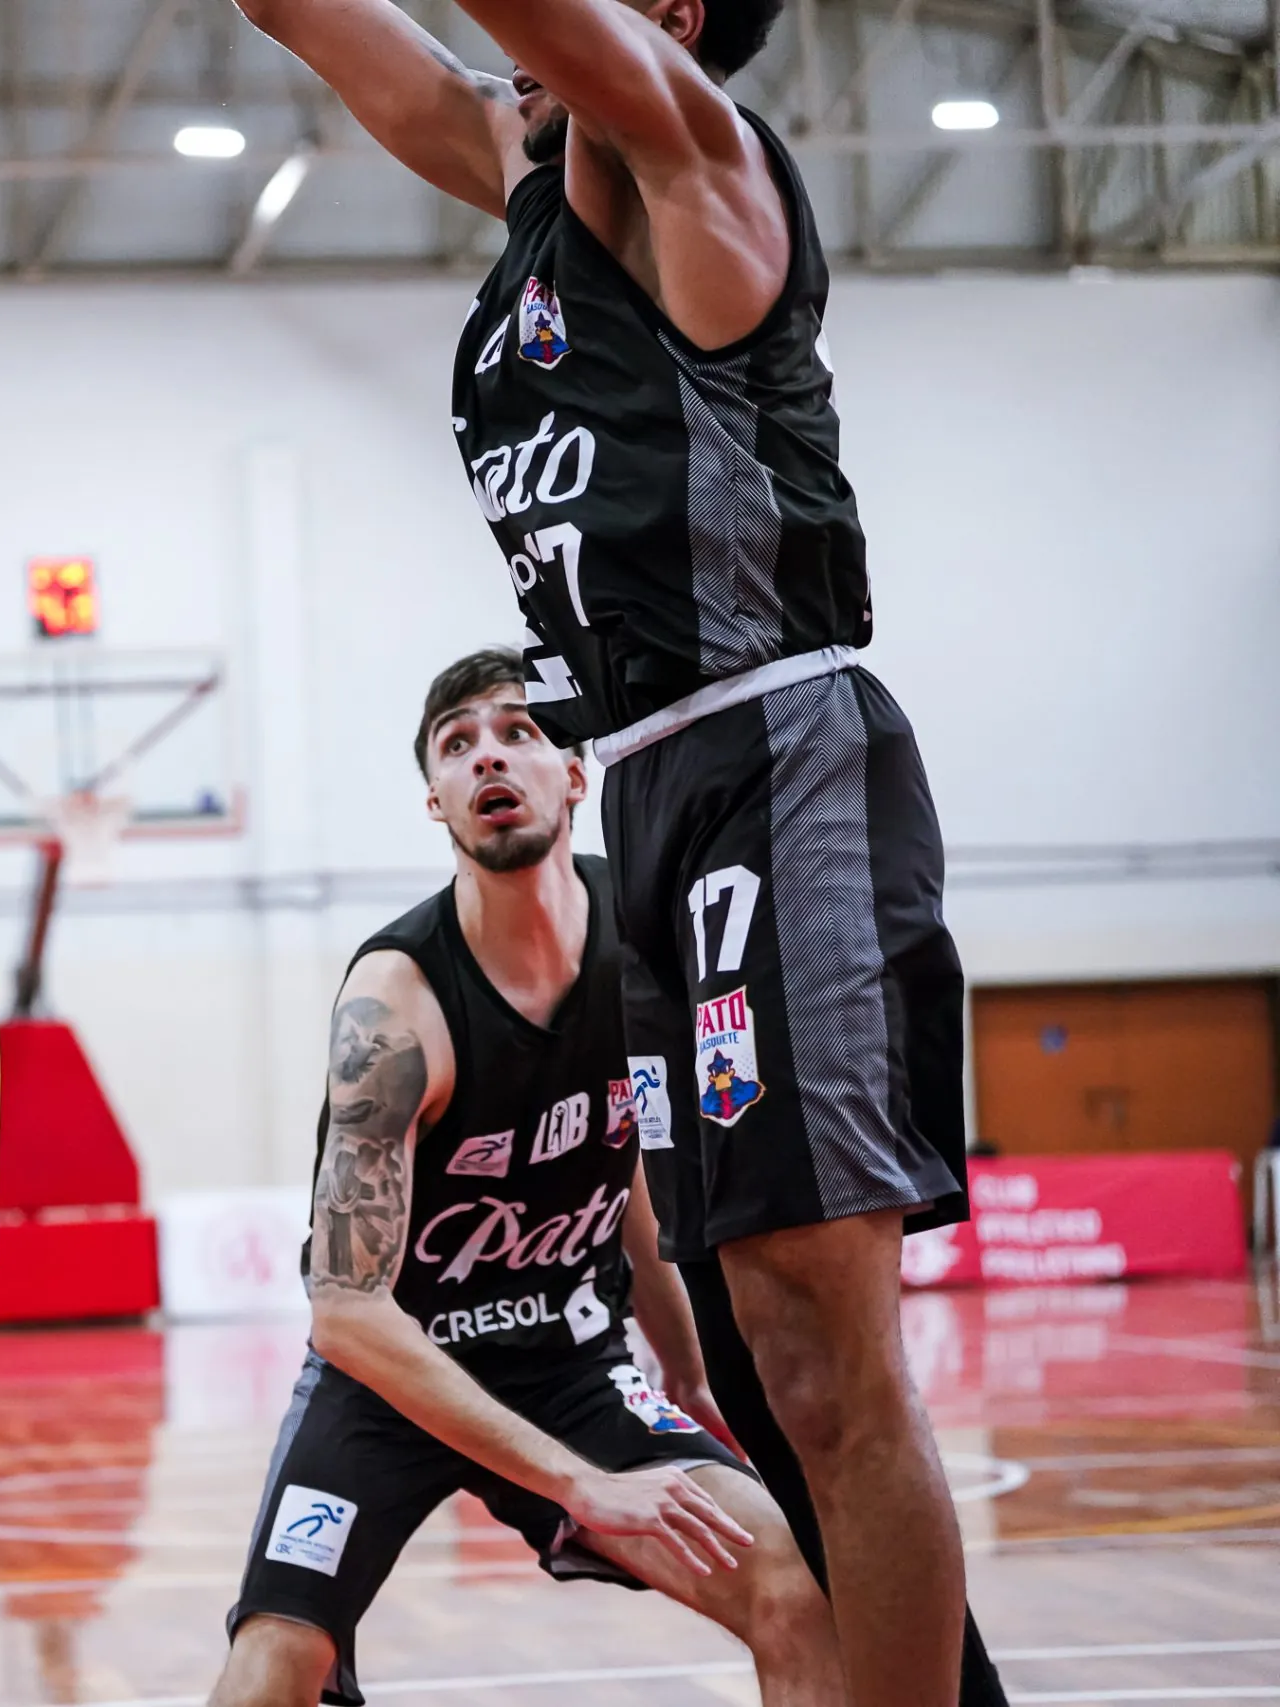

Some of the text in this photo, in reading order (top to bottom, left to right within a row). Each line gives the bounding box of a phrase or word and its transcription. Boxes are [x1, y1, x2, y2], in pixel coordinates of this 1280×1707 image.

[687, 864, 761, 983] 17
[697, 990, 747, 1040] PATO
[415, 1184, 630, 1284] Pato
[427, 1293, 560, 1345] CRESOL
